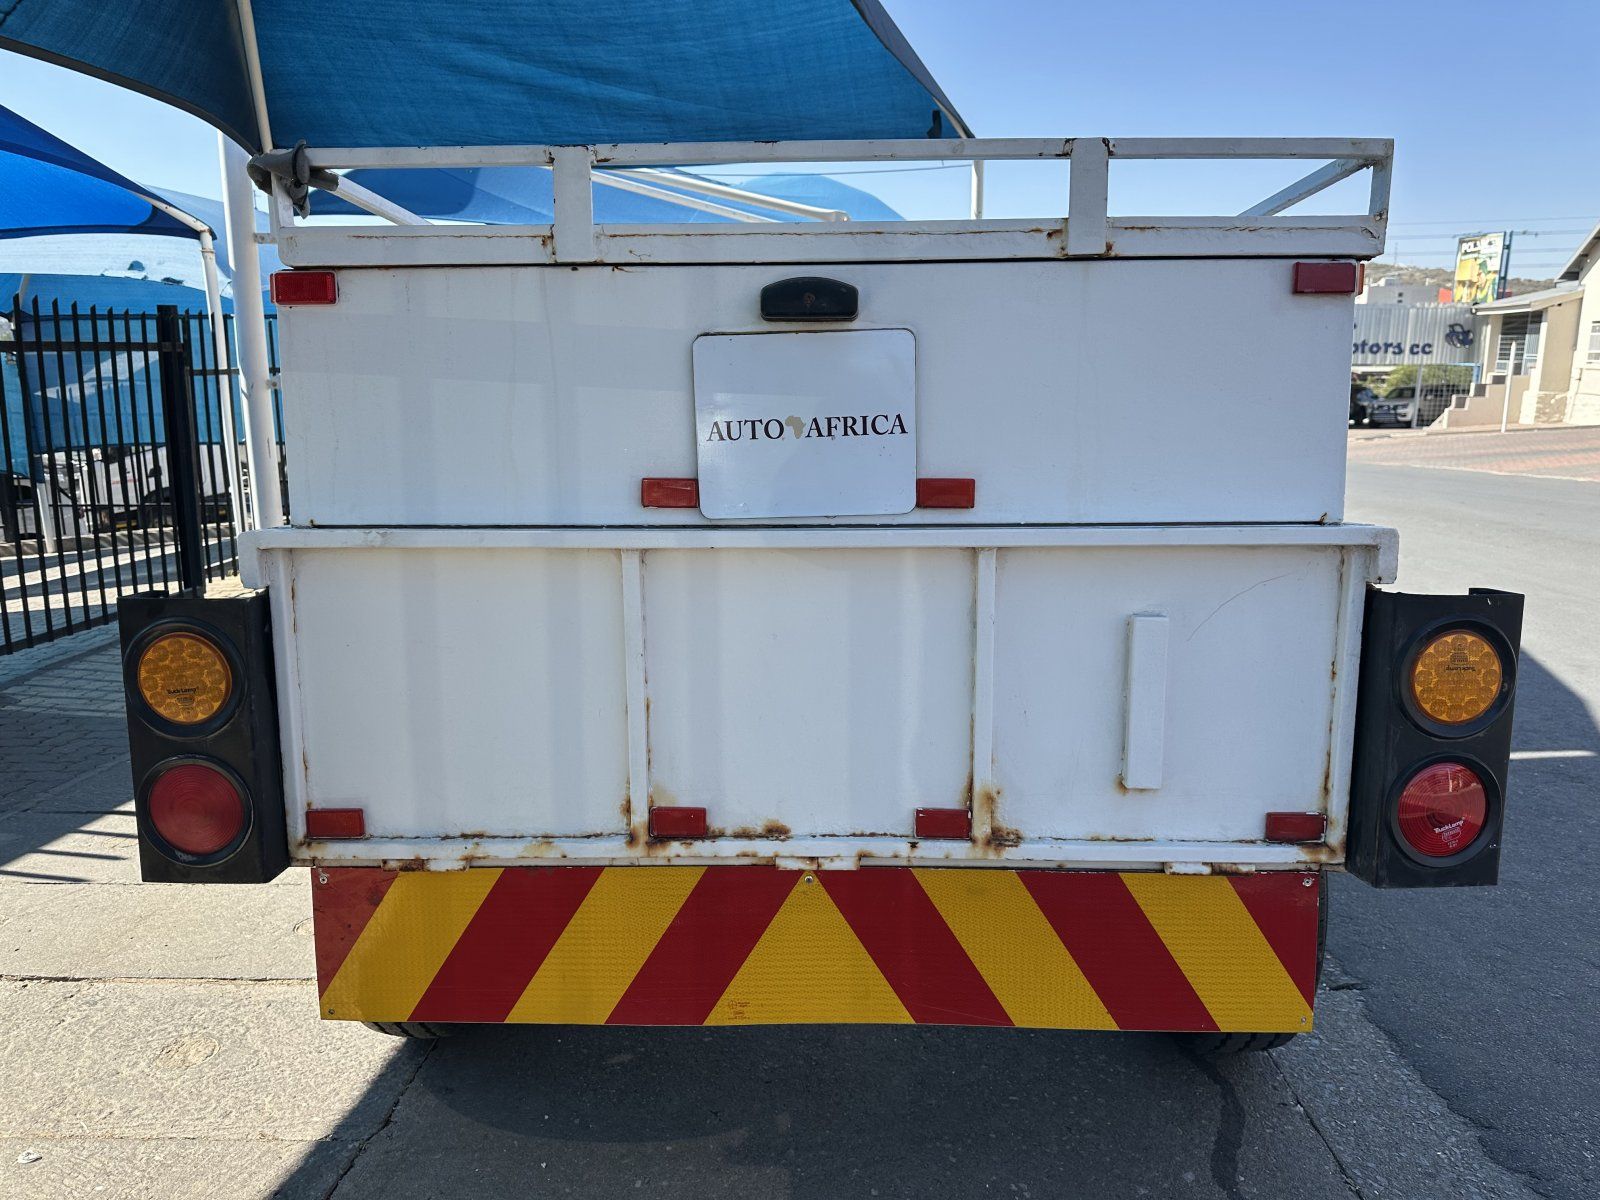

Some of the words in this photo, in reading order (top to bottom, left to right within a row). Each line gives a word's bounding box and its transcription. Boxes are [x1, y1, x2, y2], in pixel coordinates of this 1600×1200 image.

[1409, 343, 1433, 355] cc
[706, 418, 785, 442] AUTO
[805, 413, 909, 438] AFRICA
